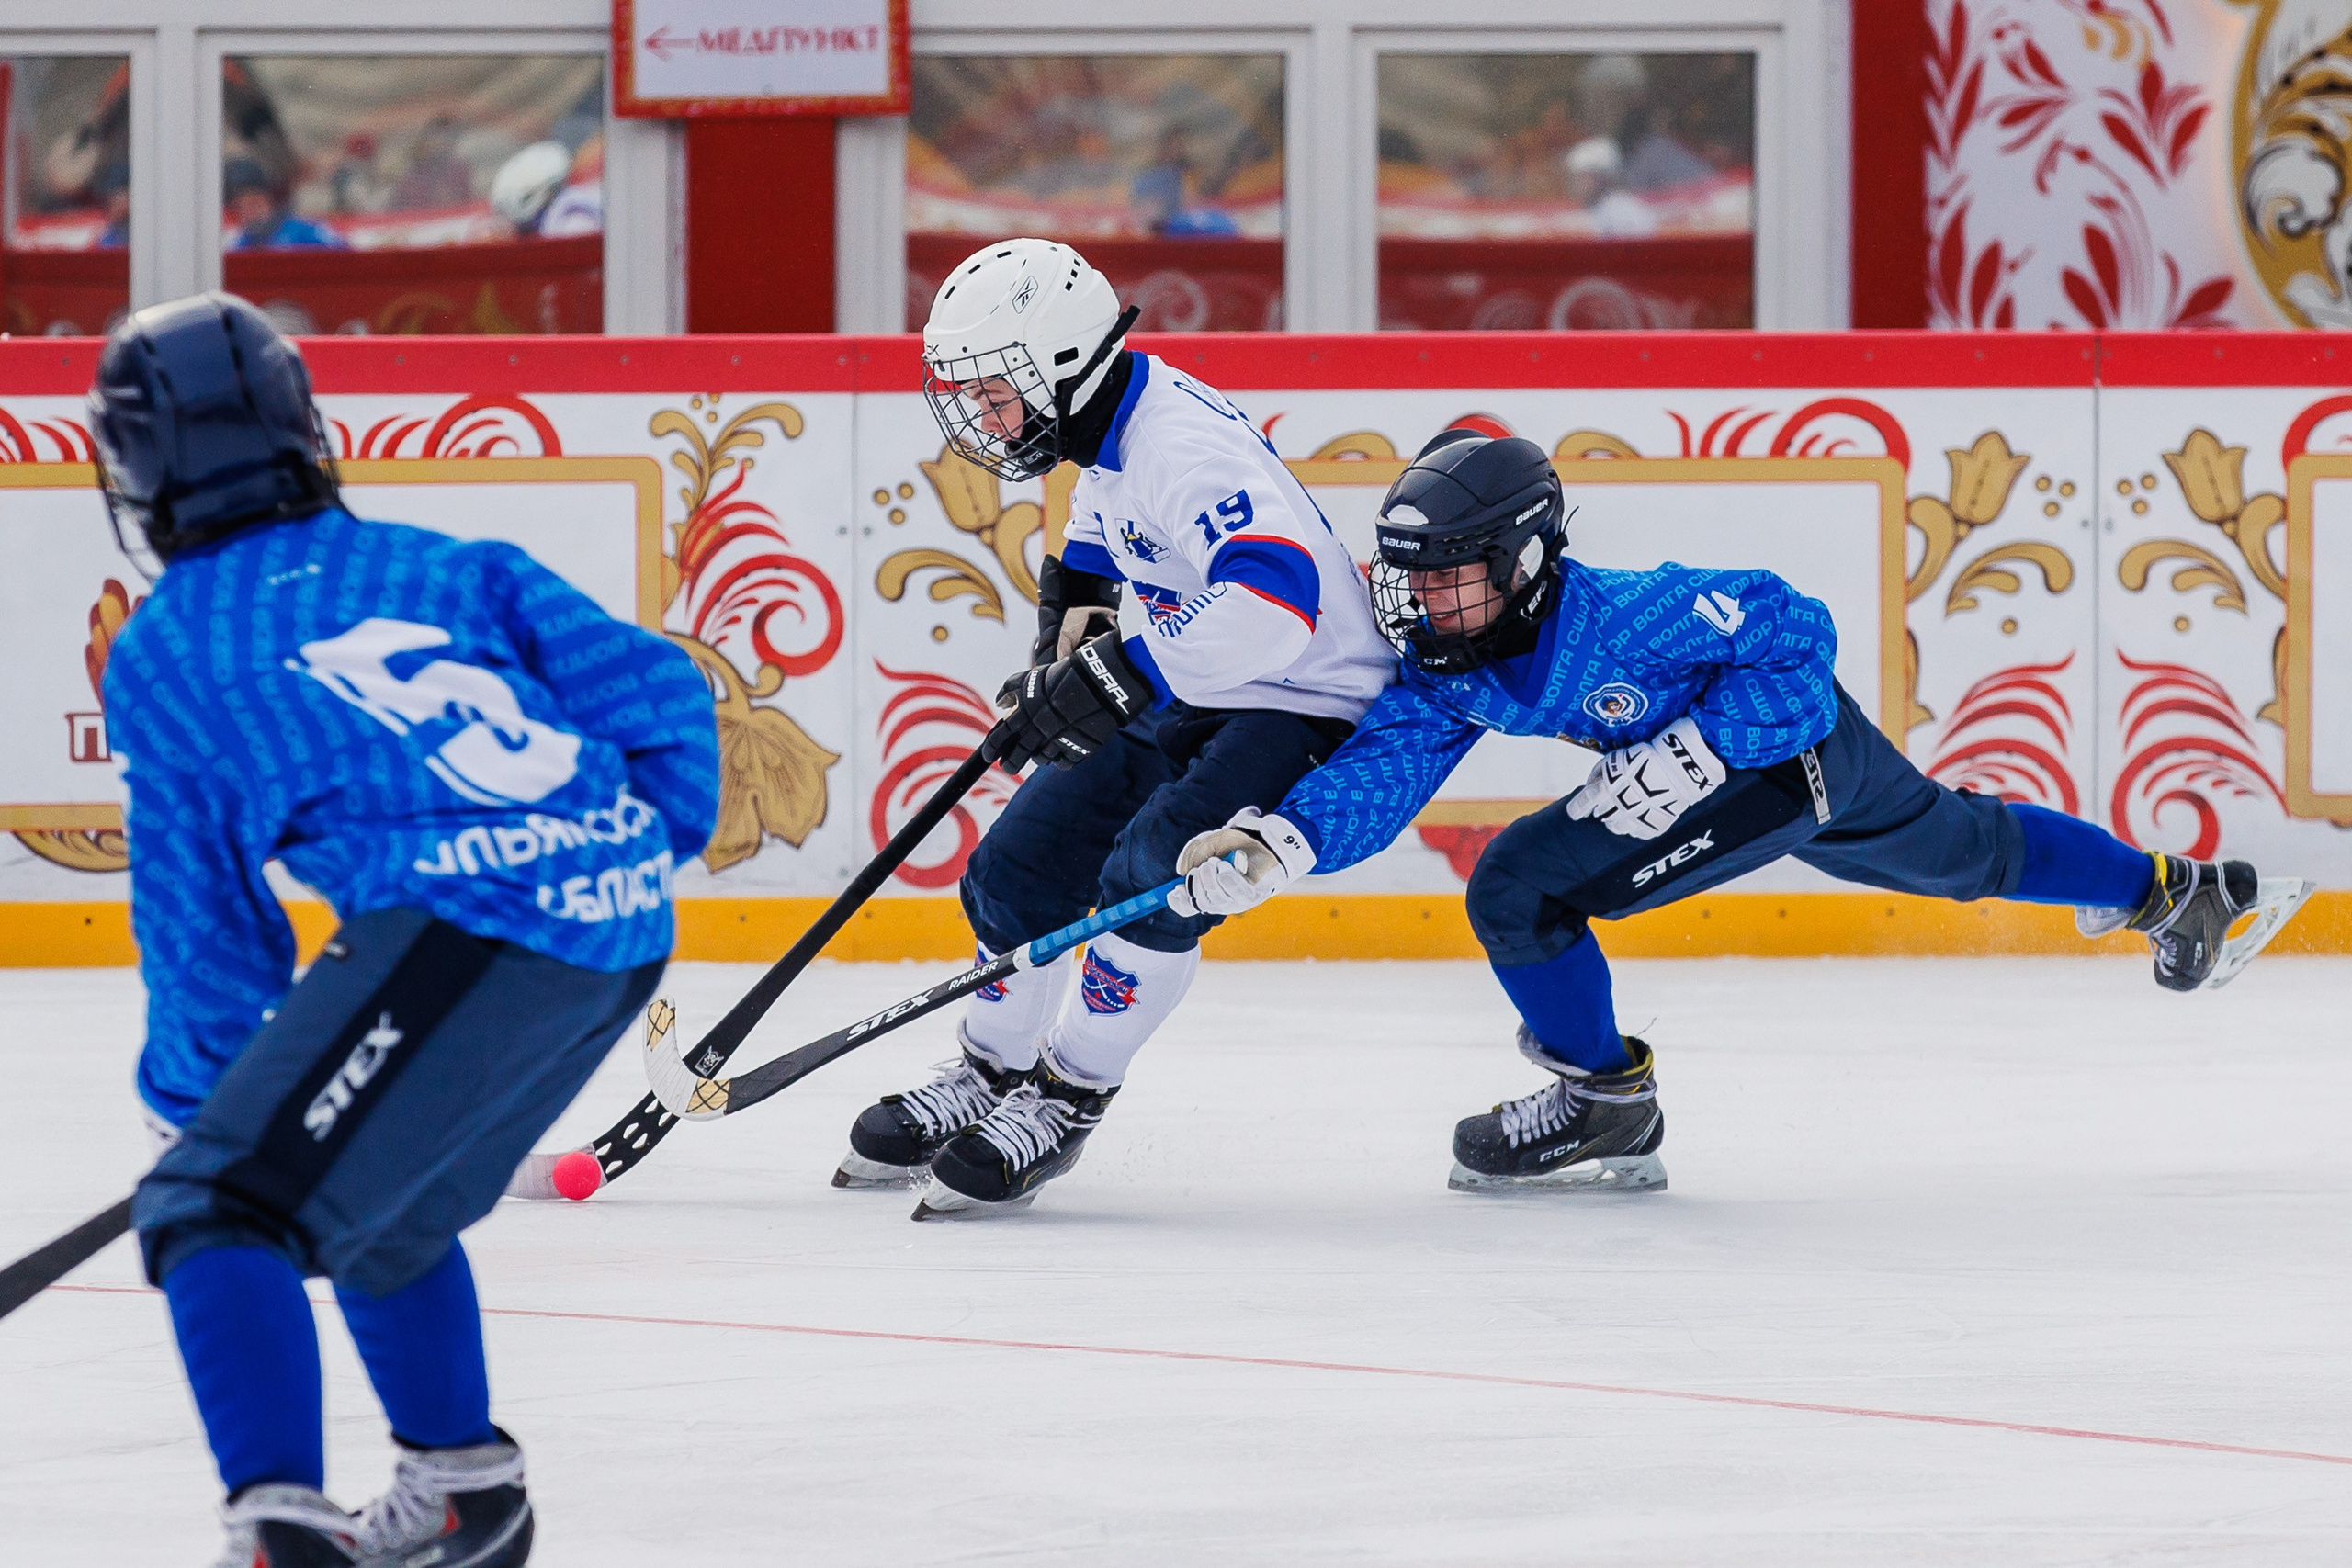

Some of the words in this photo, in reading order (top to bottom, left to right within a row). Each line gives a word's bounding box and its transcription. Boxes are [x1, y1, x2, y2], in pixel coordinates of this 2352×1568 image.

[695, 25, 881, 55] МЕДПУНКТ
[1194, 489, 1256, 551] 19
[1516, 498, 1549, 525] BAUER
[1381, 536, 1421, 551] BAUER
[1633, 586, 1690, 632] ВОЛГА
[1692, 590, 1747, 637] 4
[1541, 649, 1575, 708] ВОЛГА
[1567, 602, 1589, 646] СШО
[1736, 619, 1773, 656] ШОР
[1568, 660, 1602, 711] ВОЛГА
[1058, 736, 1091, 756] STEX
[1662, 733, 1713, 792] STEX
[1804, 750, 1824, 803] STE
[1632, 829, 1715, 888] STEX
[846, 989, 935, 1042] STEX
[947, 959, 1001, 991] RAIDER
[302, 1010, 406, 1143] STEX
[1539, 1139, 1580, 1163] CCM
